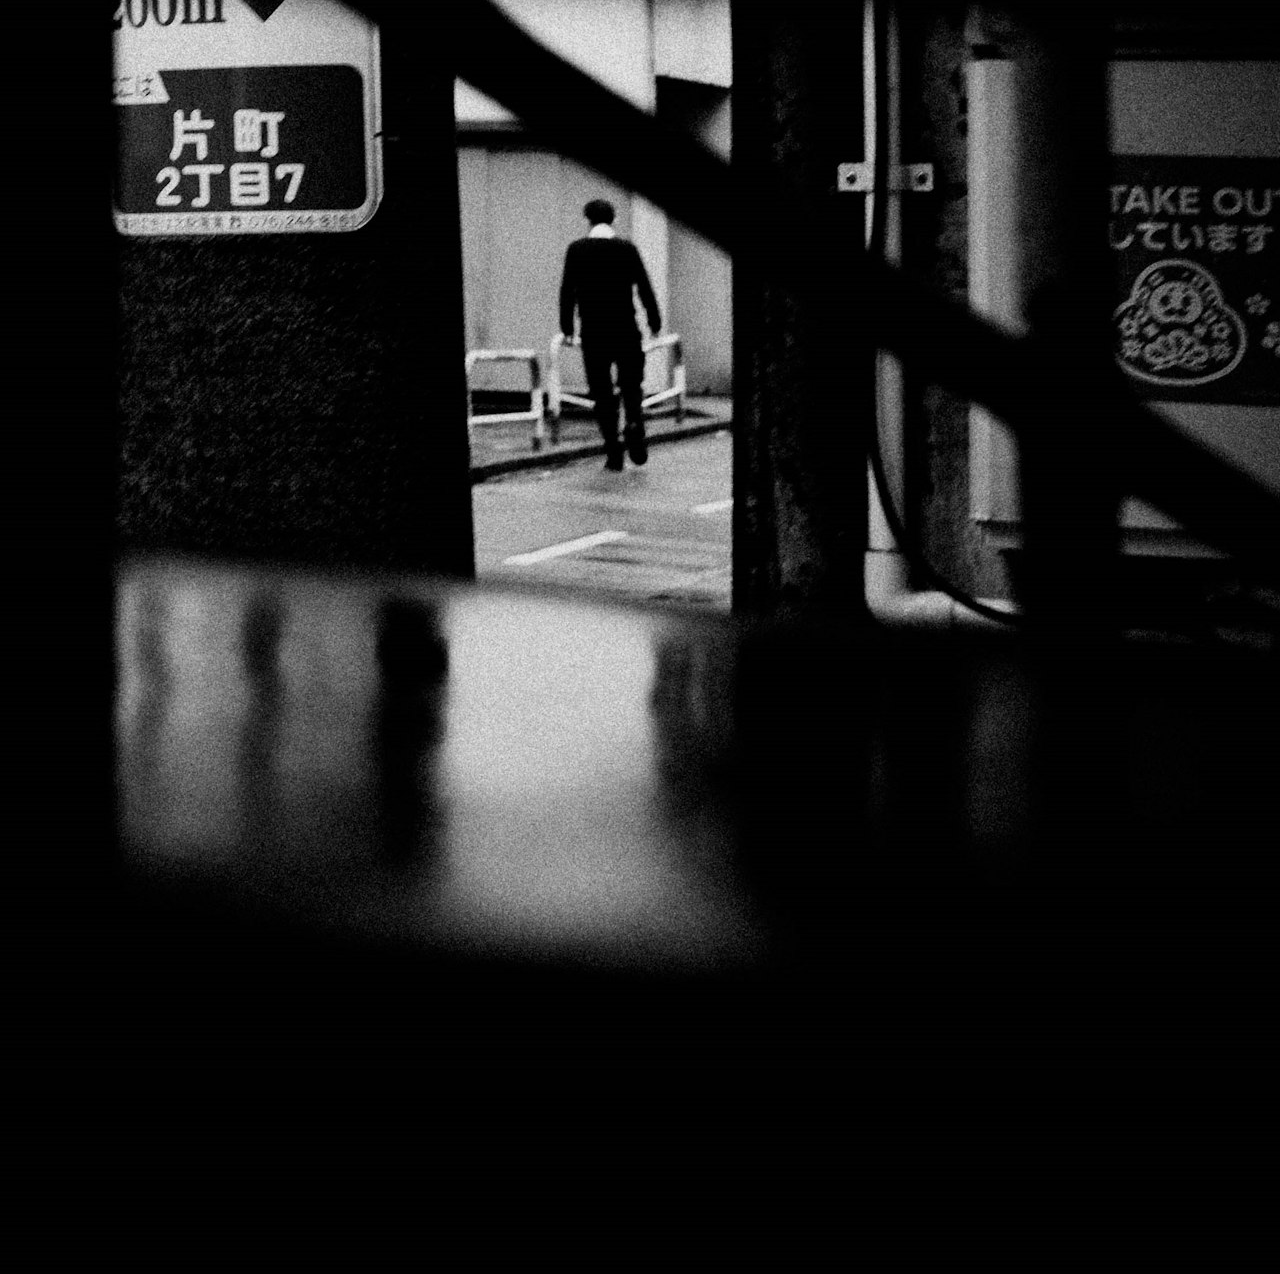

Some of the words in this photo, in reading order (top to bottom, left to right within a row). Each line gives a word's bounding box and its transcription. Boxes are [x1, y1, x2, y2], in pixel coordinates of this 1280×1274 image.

[155, 162, 305, 208] 2丁目7
[1108, 185, 1202, 216] TAKE
[1212, 186, 1280, 217] OU
[1107, 220, 1275, 255] しています
